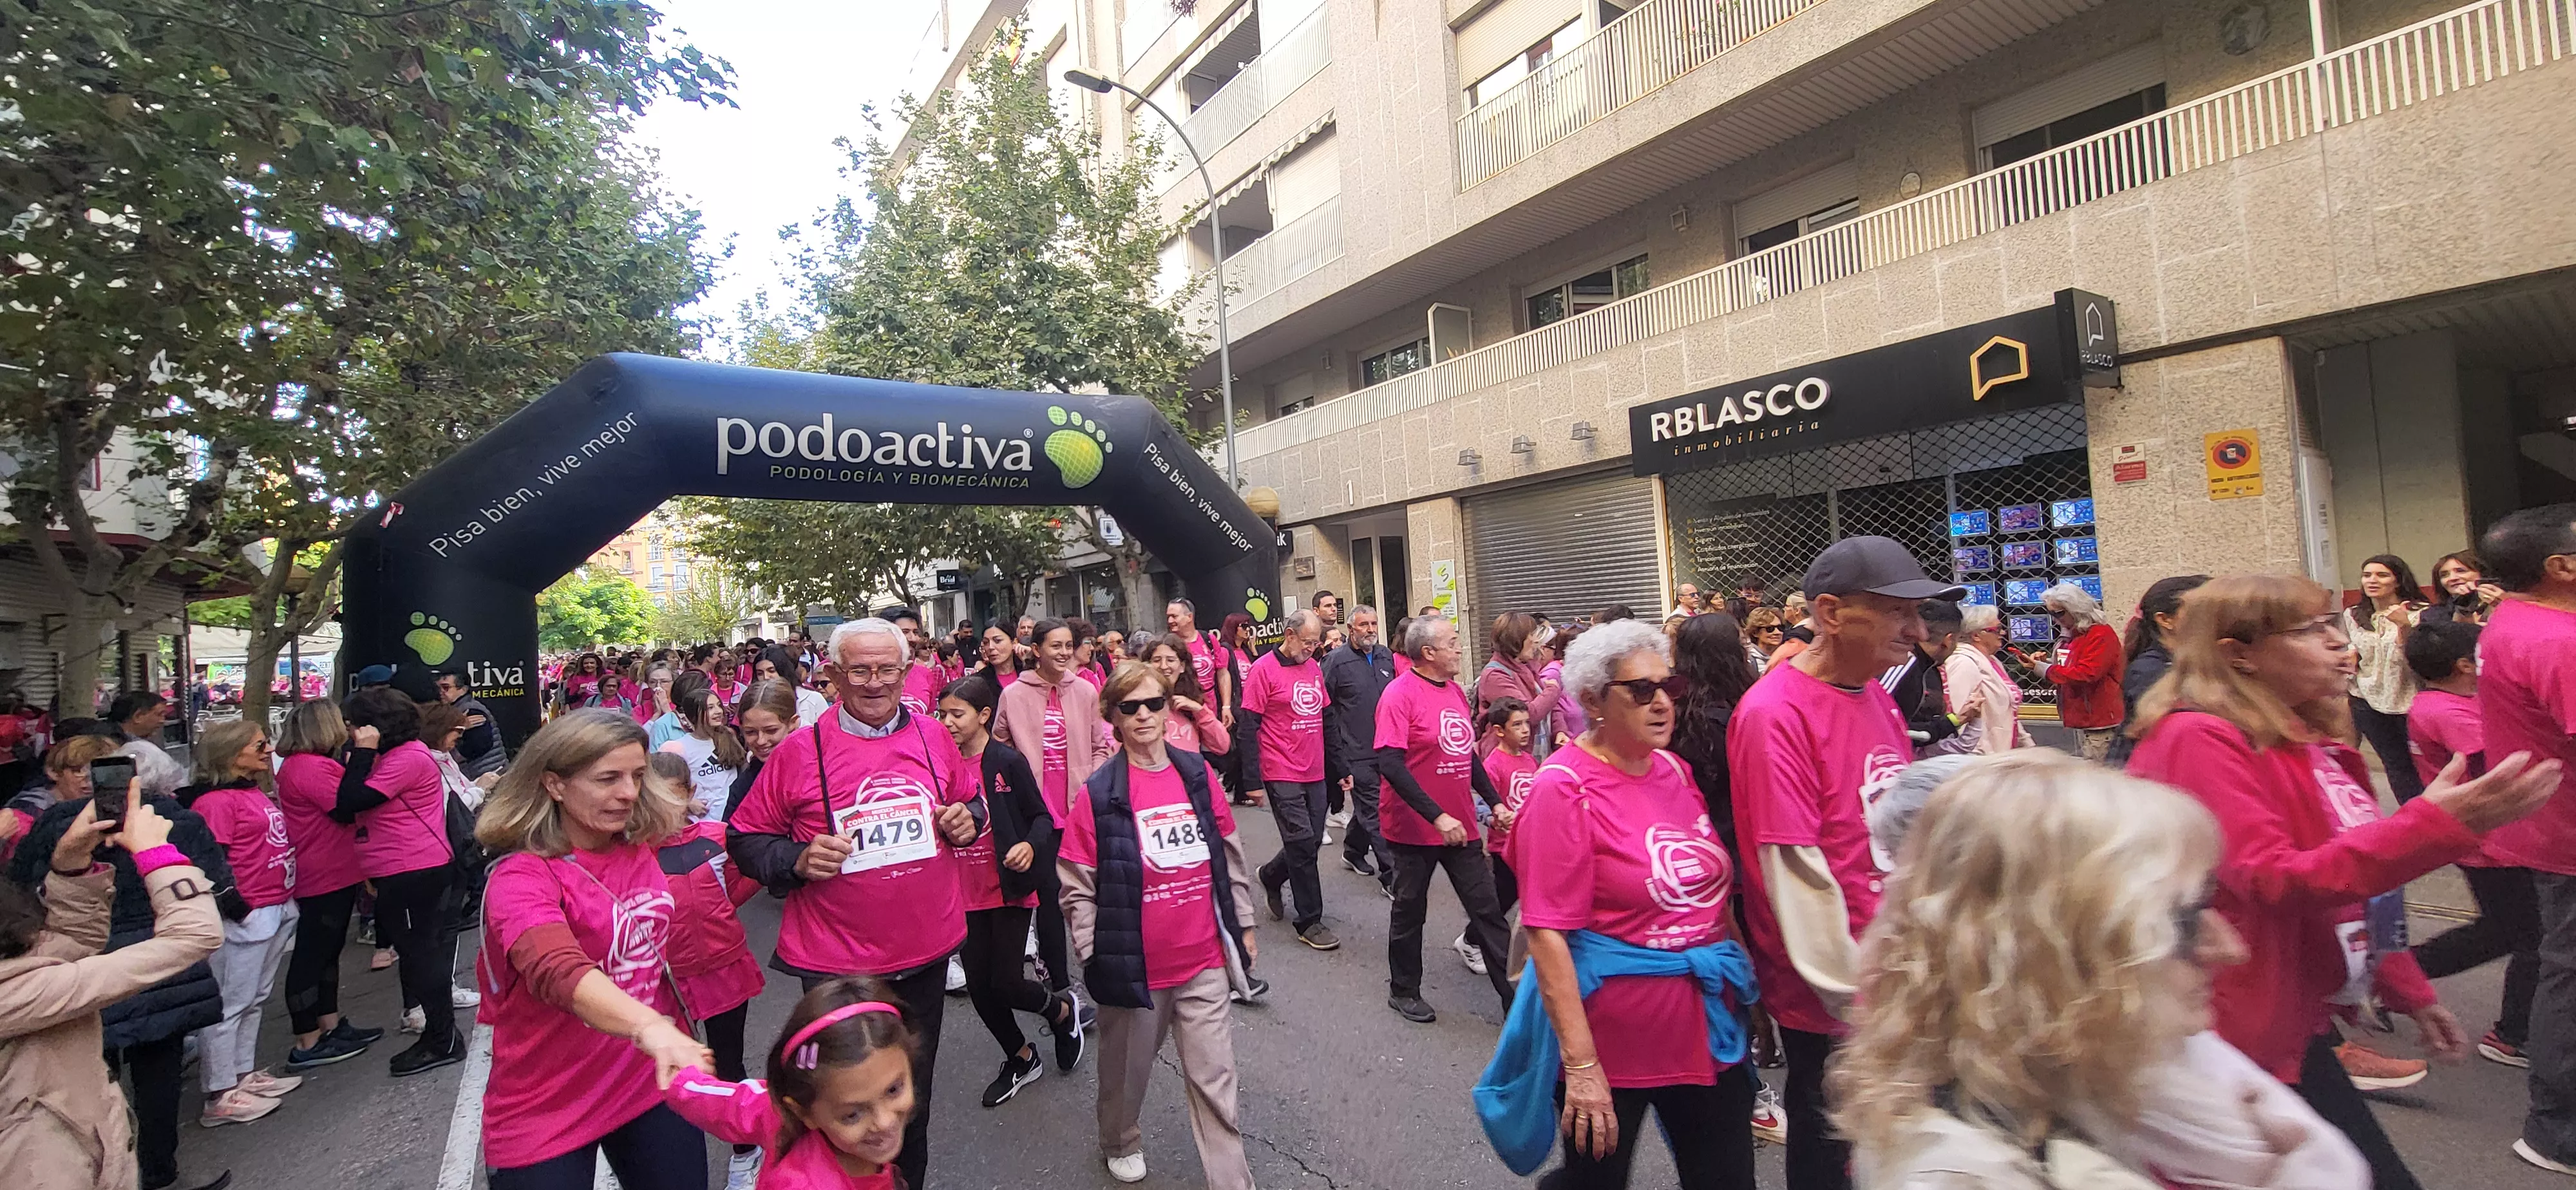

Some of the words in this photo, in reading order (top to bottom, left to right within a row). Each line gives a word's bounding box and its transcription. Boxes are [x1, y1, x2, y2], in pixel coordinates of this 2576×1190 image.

[1651, 377, 1831, 442] RBLASCO
[1674, 420, 1819, 455] inmobiliaria
[428, 520, 487, 558] Pisa
[479, 486, 543, 524] bien,
[537, 454, 582, 485] vive
[580, 411, 638, 458] mejor
[770, 465, 885, 483] PODOLOGÍA
[892, 471, 903, 484] Y
[909, 472, 1030, 489] BIOMECÁNICA
[1144, 442, 1170, 474] Pisa
[1169, 469, 1195, 503] bien,
[1198, 498, 1220, 523] vive
[1219, 520, 1253, 551] mejor
[847, 815, 879, 827] CONTRA
[889, 809, 920, 818] CÁNCER
[851, 818, 923, 851] 1479
